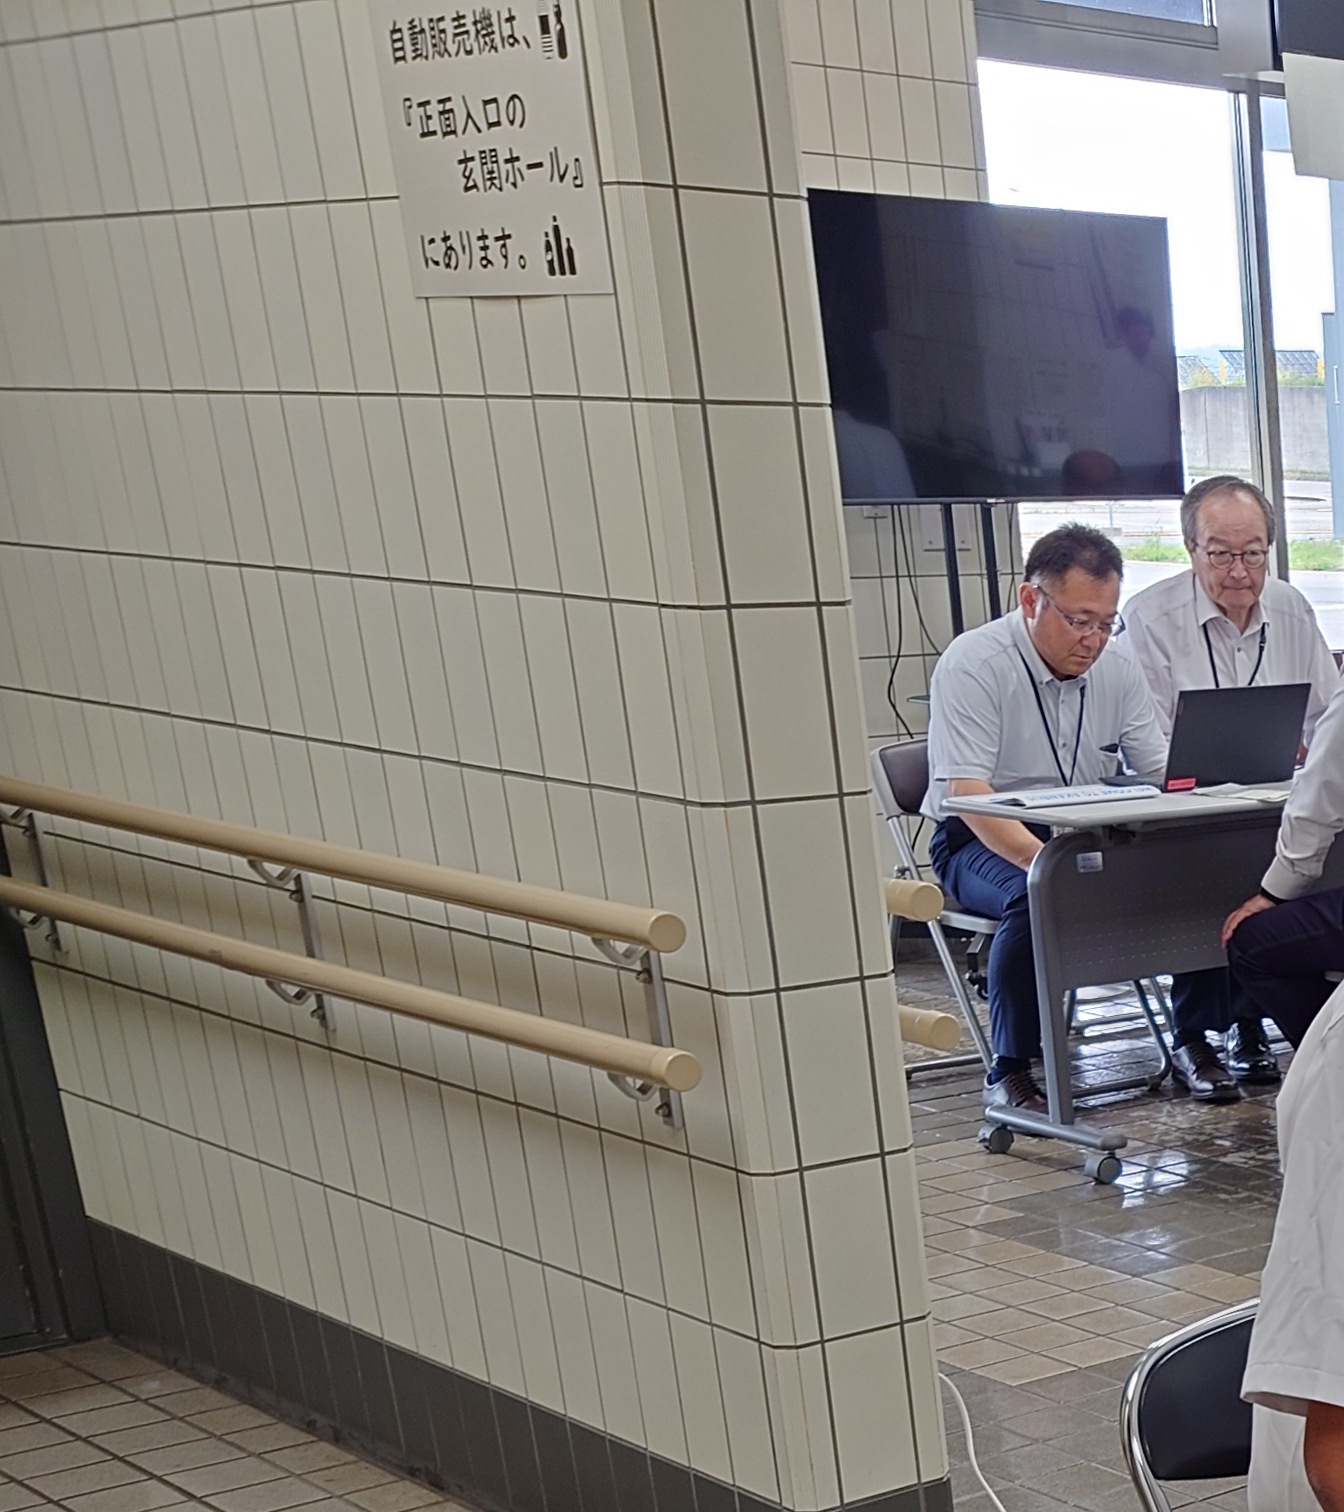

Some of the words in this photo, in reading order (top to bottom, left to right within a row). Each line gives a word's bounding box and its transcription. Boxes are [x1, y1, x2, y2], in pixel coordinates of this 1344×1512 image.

[389, 7, 531, 65] 自動販売機は、
[403, 93, 526, 139] 『正面入口の
[457, 147, 584, 193] 玄関ホール』
[420, 227, 527, 271] にあります。
